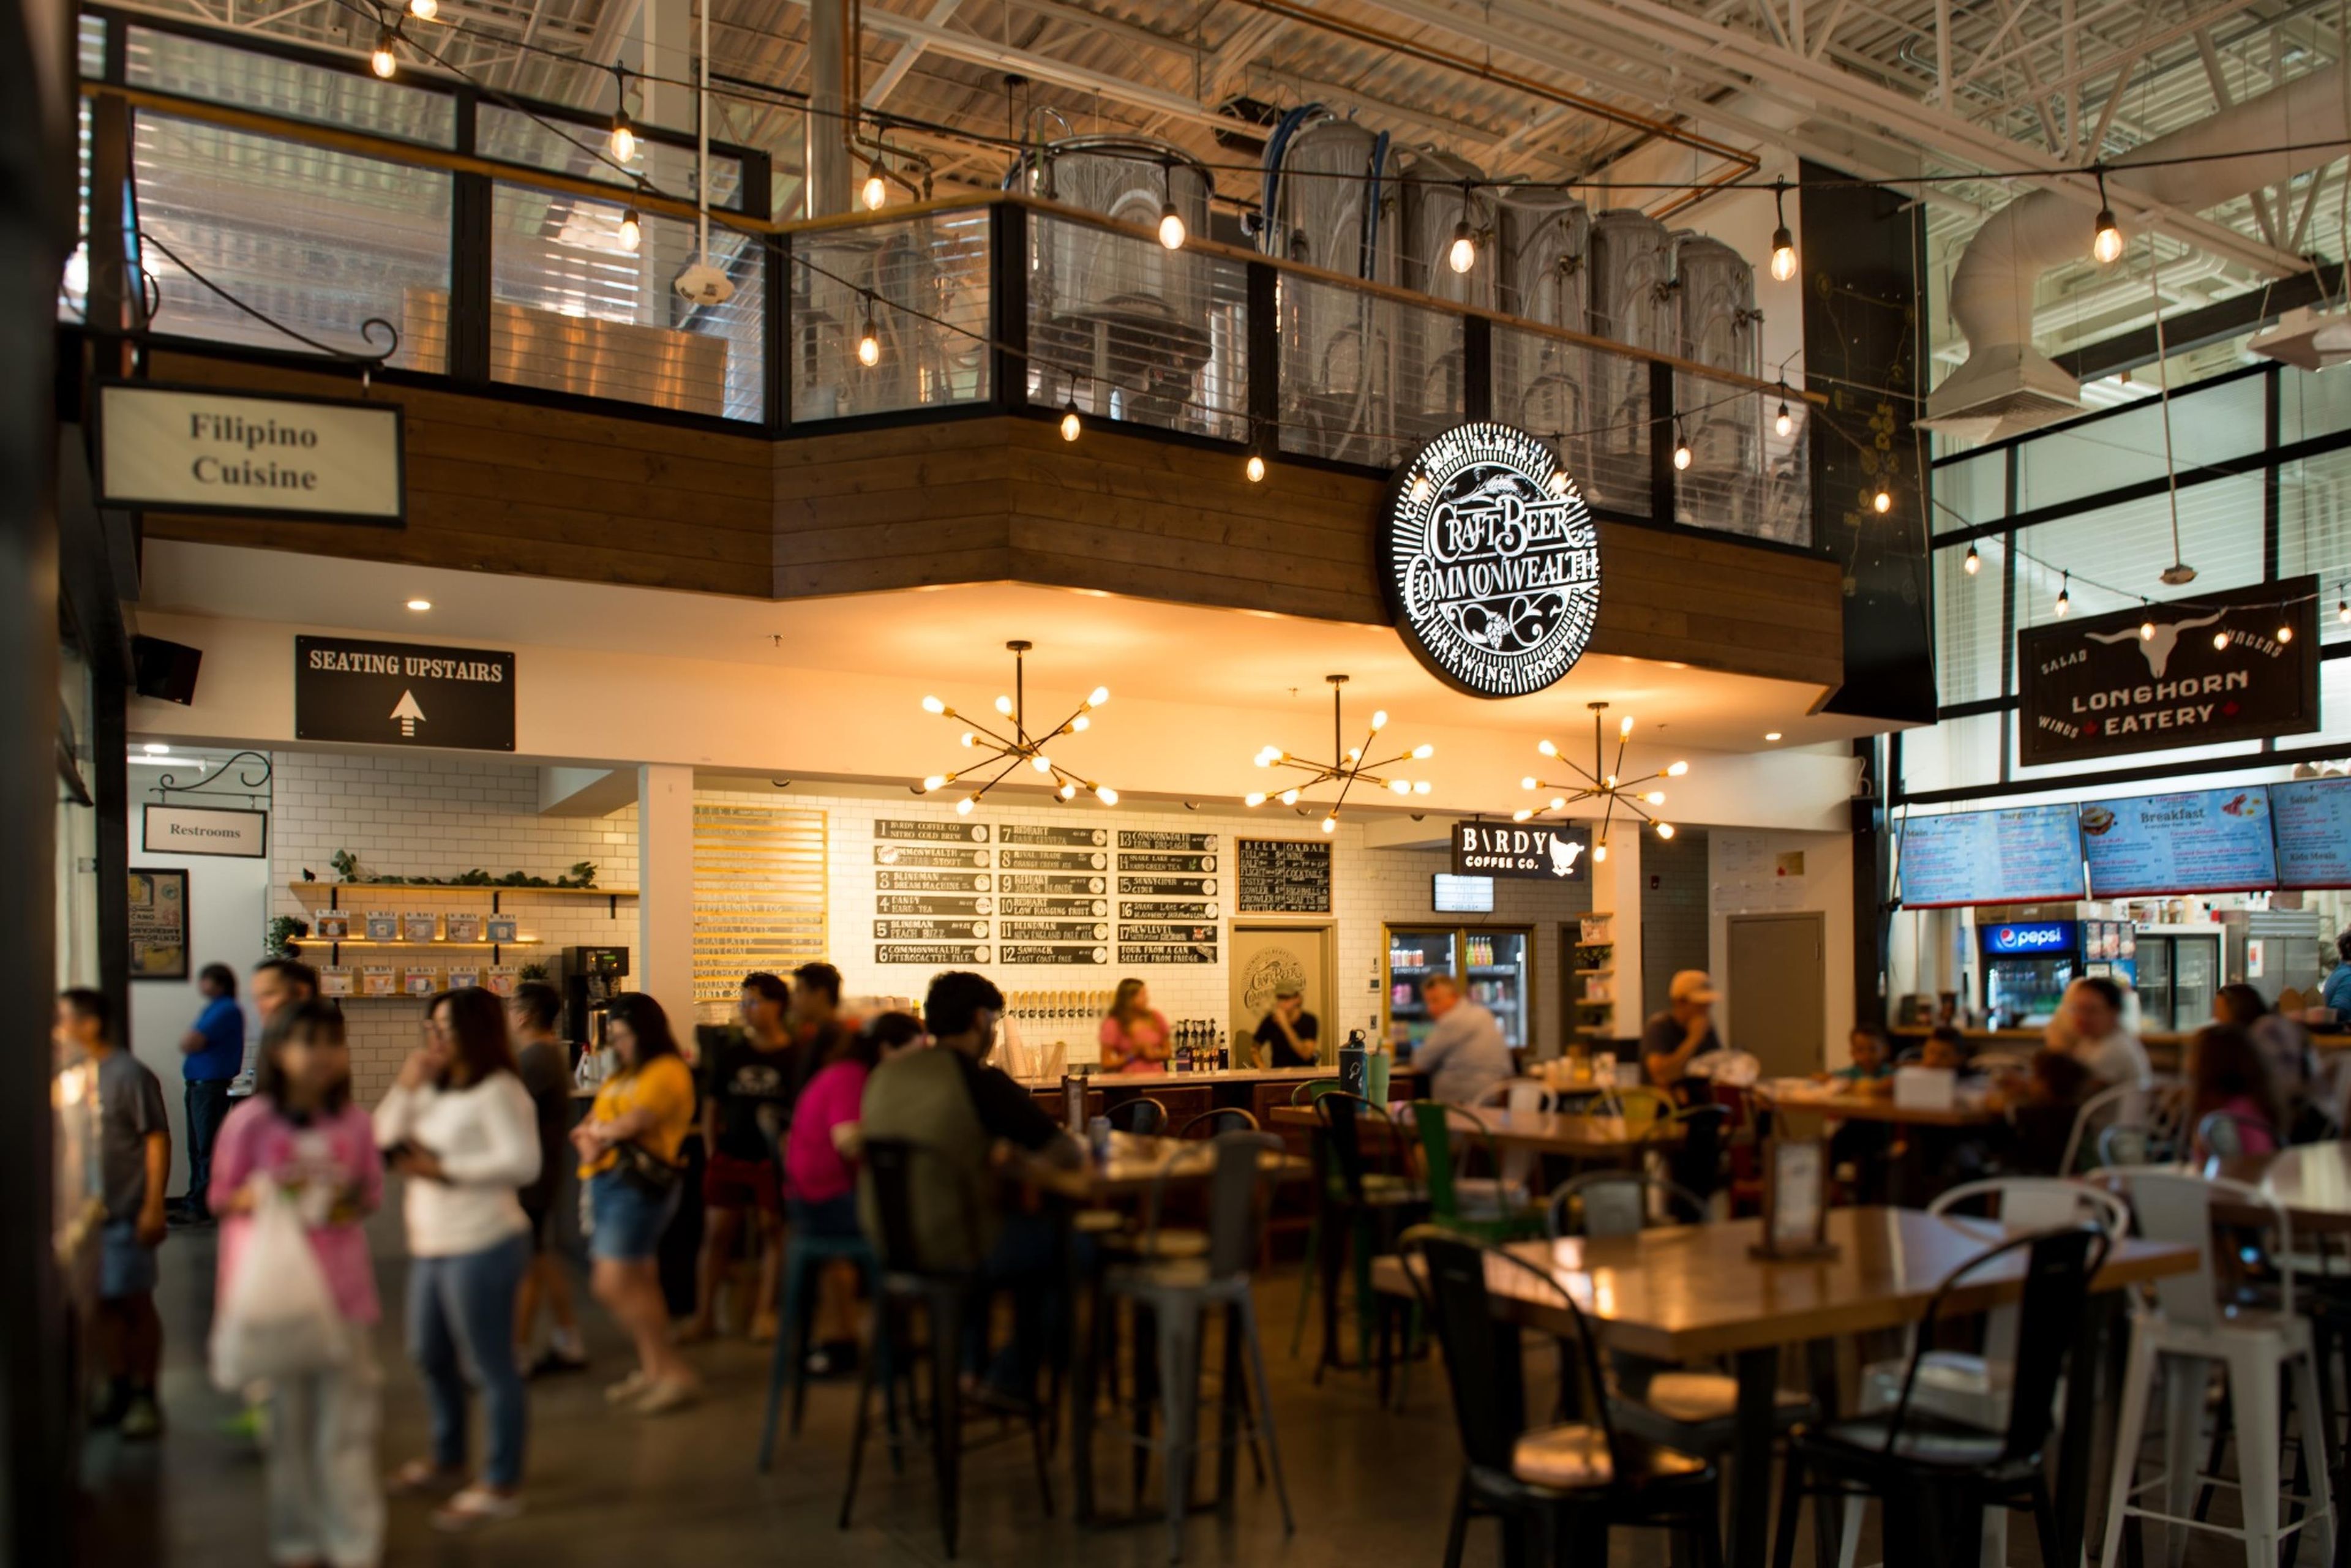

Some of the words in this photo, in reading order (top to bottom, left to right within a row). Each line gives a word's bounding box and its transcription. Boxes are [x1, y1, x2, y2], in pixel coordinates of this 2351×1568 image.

[190, 413, 318, 451] Filipino
[191, 456, 318, 490] Cuisine
[1405, 440, 1464, 520] CRAL
[1472, 433, 1546, 476] ALBERTA
[1430, 503, 1501, 563] CRAFT
[1495, 495, 1586, 557] BEER
[1405, 547, 1599, 621] COMMONWEALTH
[1428, 625, 1512, 683] BREWING
[1524, 599, 1591, 680] TOGETHER
[2227, 629, 2283, 658] URGERS
[309, 650, 400, 675] SEATING
[405, 656, 503, 683] UPSTAIRS
[2041, 649, 2087, 675] SALAD
[2072, 670, 2248, 713] LONGHORN
[2038, 715, 2080, 740] WINGS
[2104, 703, 2214, 736] EATERY
[2141, 808, 2205, 823] Breakfast
[170, 823, 241, 839] Restrooms
[880, 822, 886, 836] 1
[1002, 828, 1011, 841] 7
[1119, 832, 1131, 847] 13
[1002, 851, 1010, 867] 8
[1119, 855, 1128, 869] 14
[1465, 856, 1513, 869] COFFEE
[1518, 858, 1539, 869] CO.
[1002, 876, 1012, 892] 9
[1119, 878, 1131, 893] 15
[880, 896, 890, 912] 4
[1001, 898, 1013, 913] 10
[1121, 903, 1133, 917] 16
[877, 922, 887, 937] 5
[1001, 922, 1011, 937] 11
[1120, 926, 1130, 940] 17
[2017, 928, 2062, 947] pepsi
[879, 946, 888, 962] 6
[888, 945, 961, 954] COMMONWEALTH
[1003, 947, 1016, 962] 12
